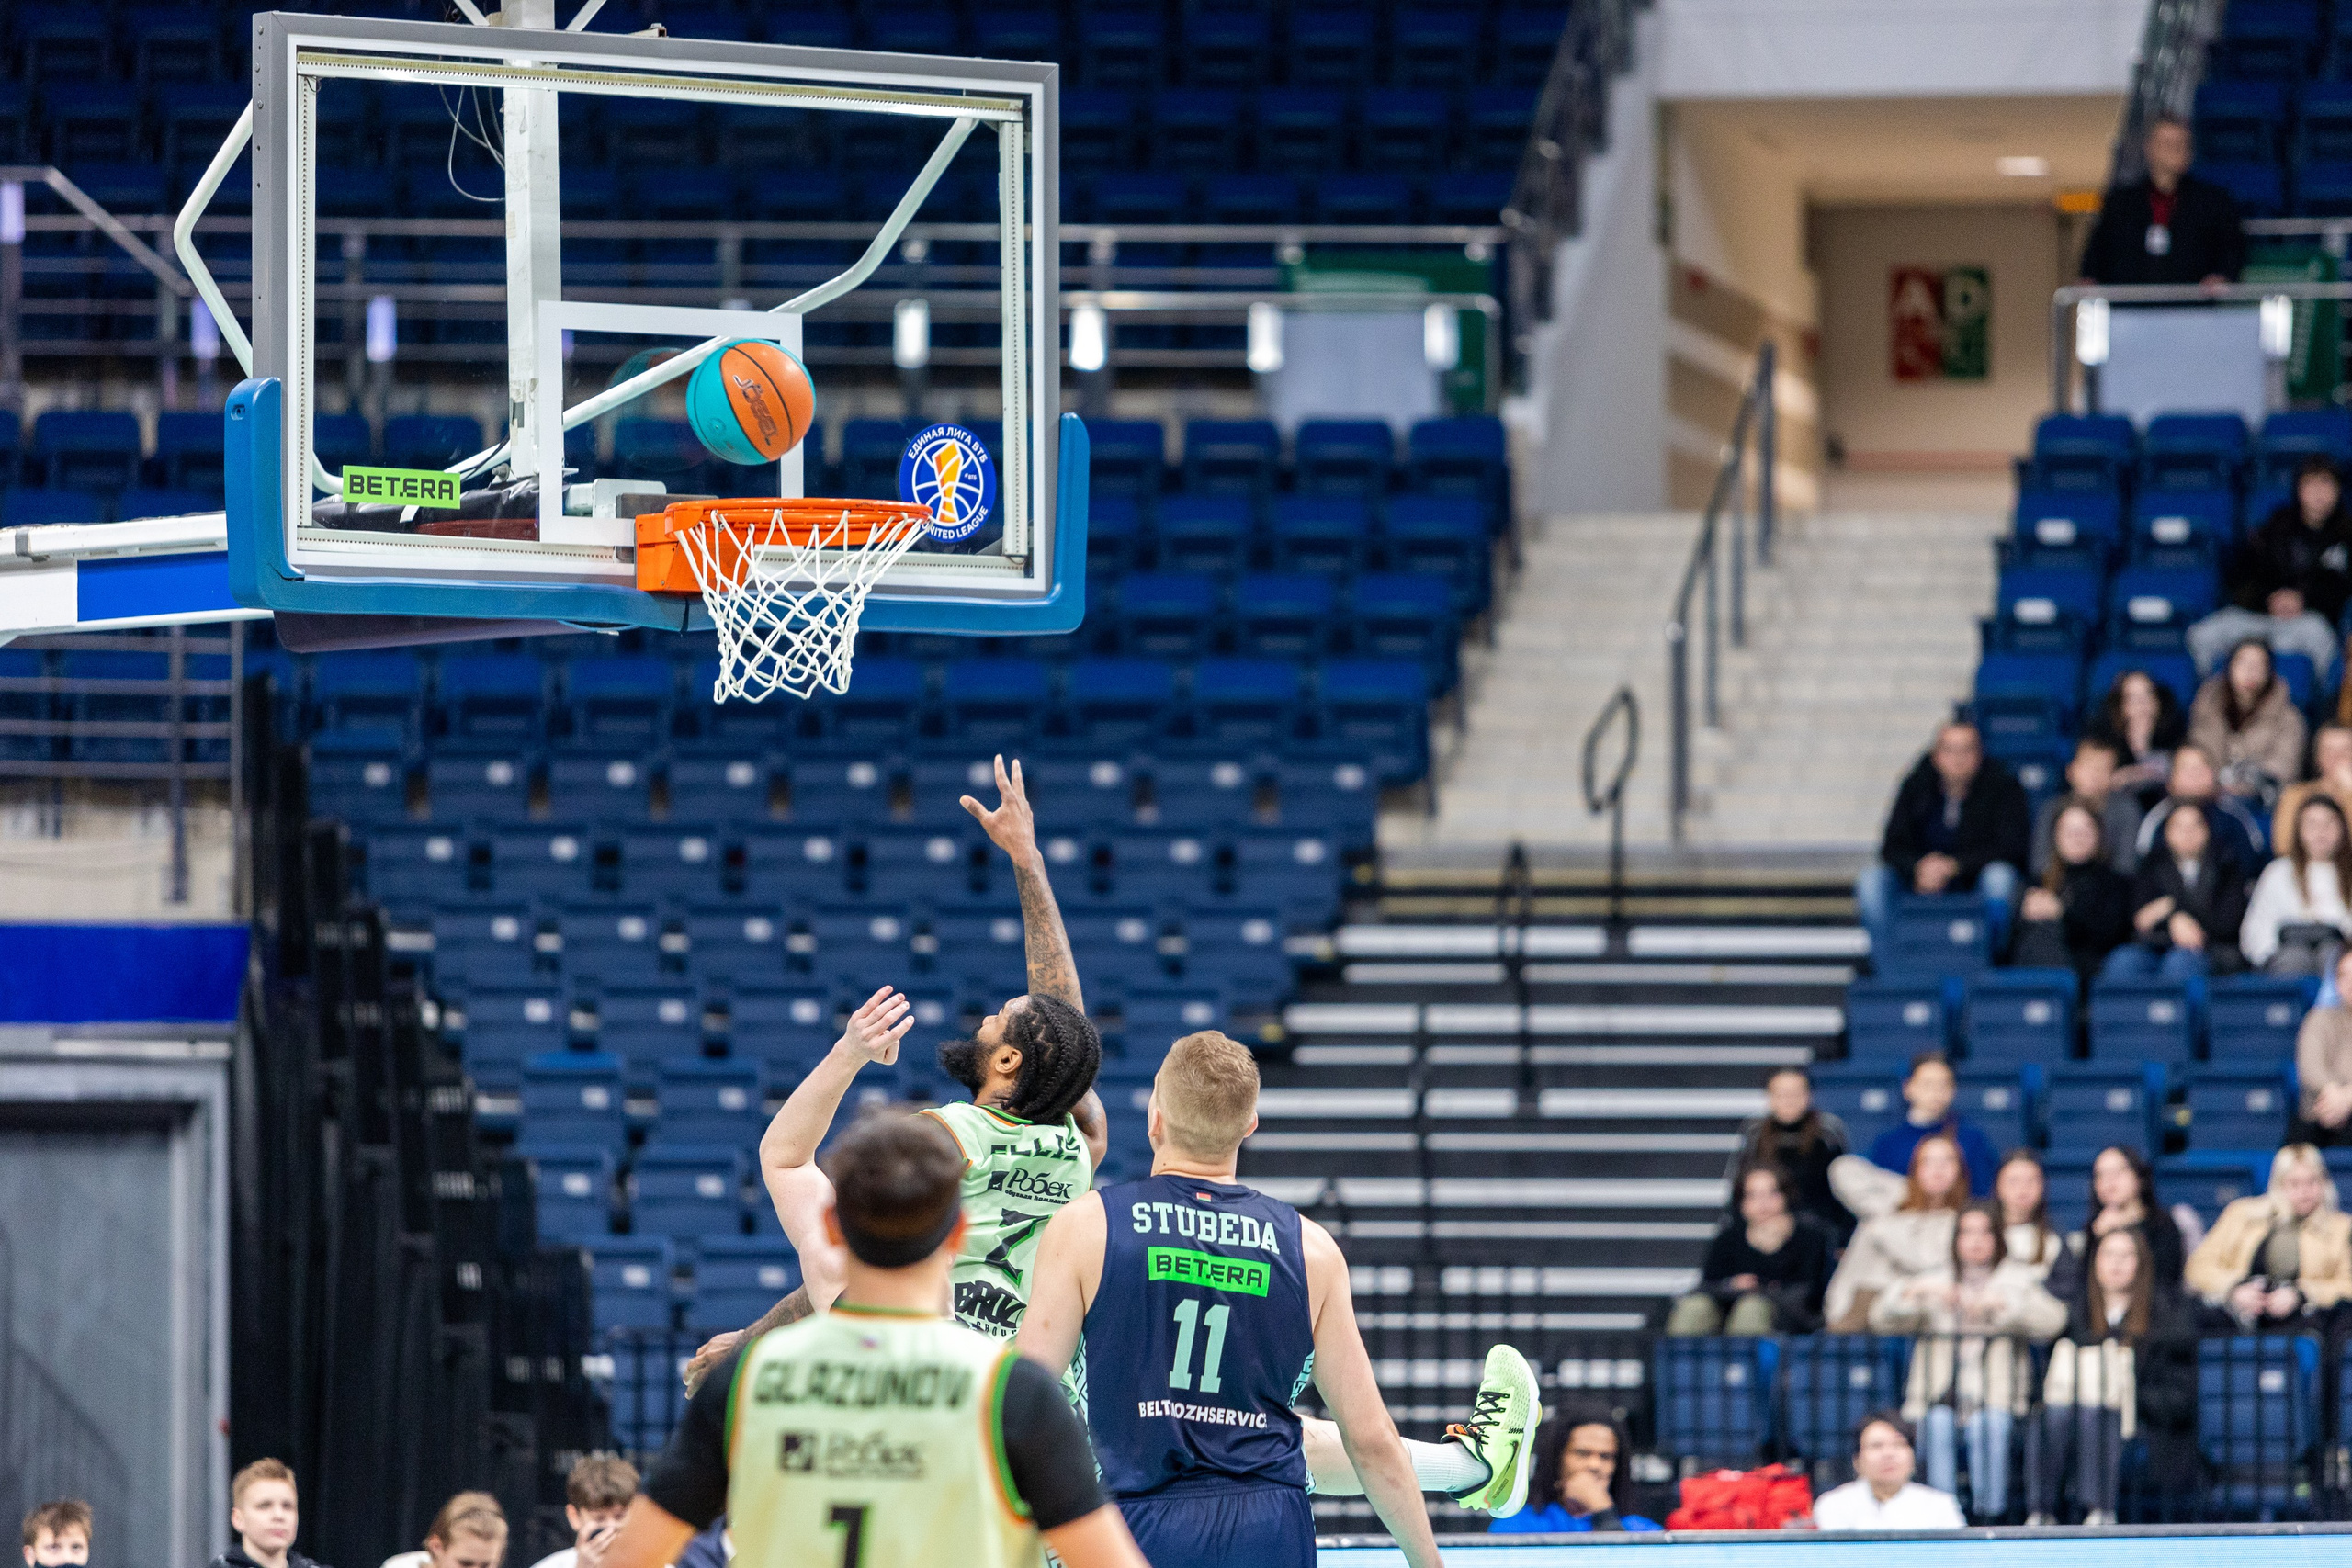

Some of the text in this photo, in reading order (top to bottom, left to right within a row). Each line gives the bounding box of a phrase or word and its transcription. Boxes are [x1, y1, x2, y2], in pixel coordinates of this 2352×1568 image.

[908, 426, 988, 463] ЕДИНАЯ ЛИГА ВТБ
[349, 474, 454, 501] BETERA
[956, 505, 989, 537] LEAGUE
[1007, 1168, 1074, 1199] Робек
[1132, 1201, 1280, 1255] STUBEDA
[1156, 1254, 1263, 1288] BETERA
[1169, 1298, 1230, 1393] 11
[755, 1360, 972, 1408] GLAZUNOV
